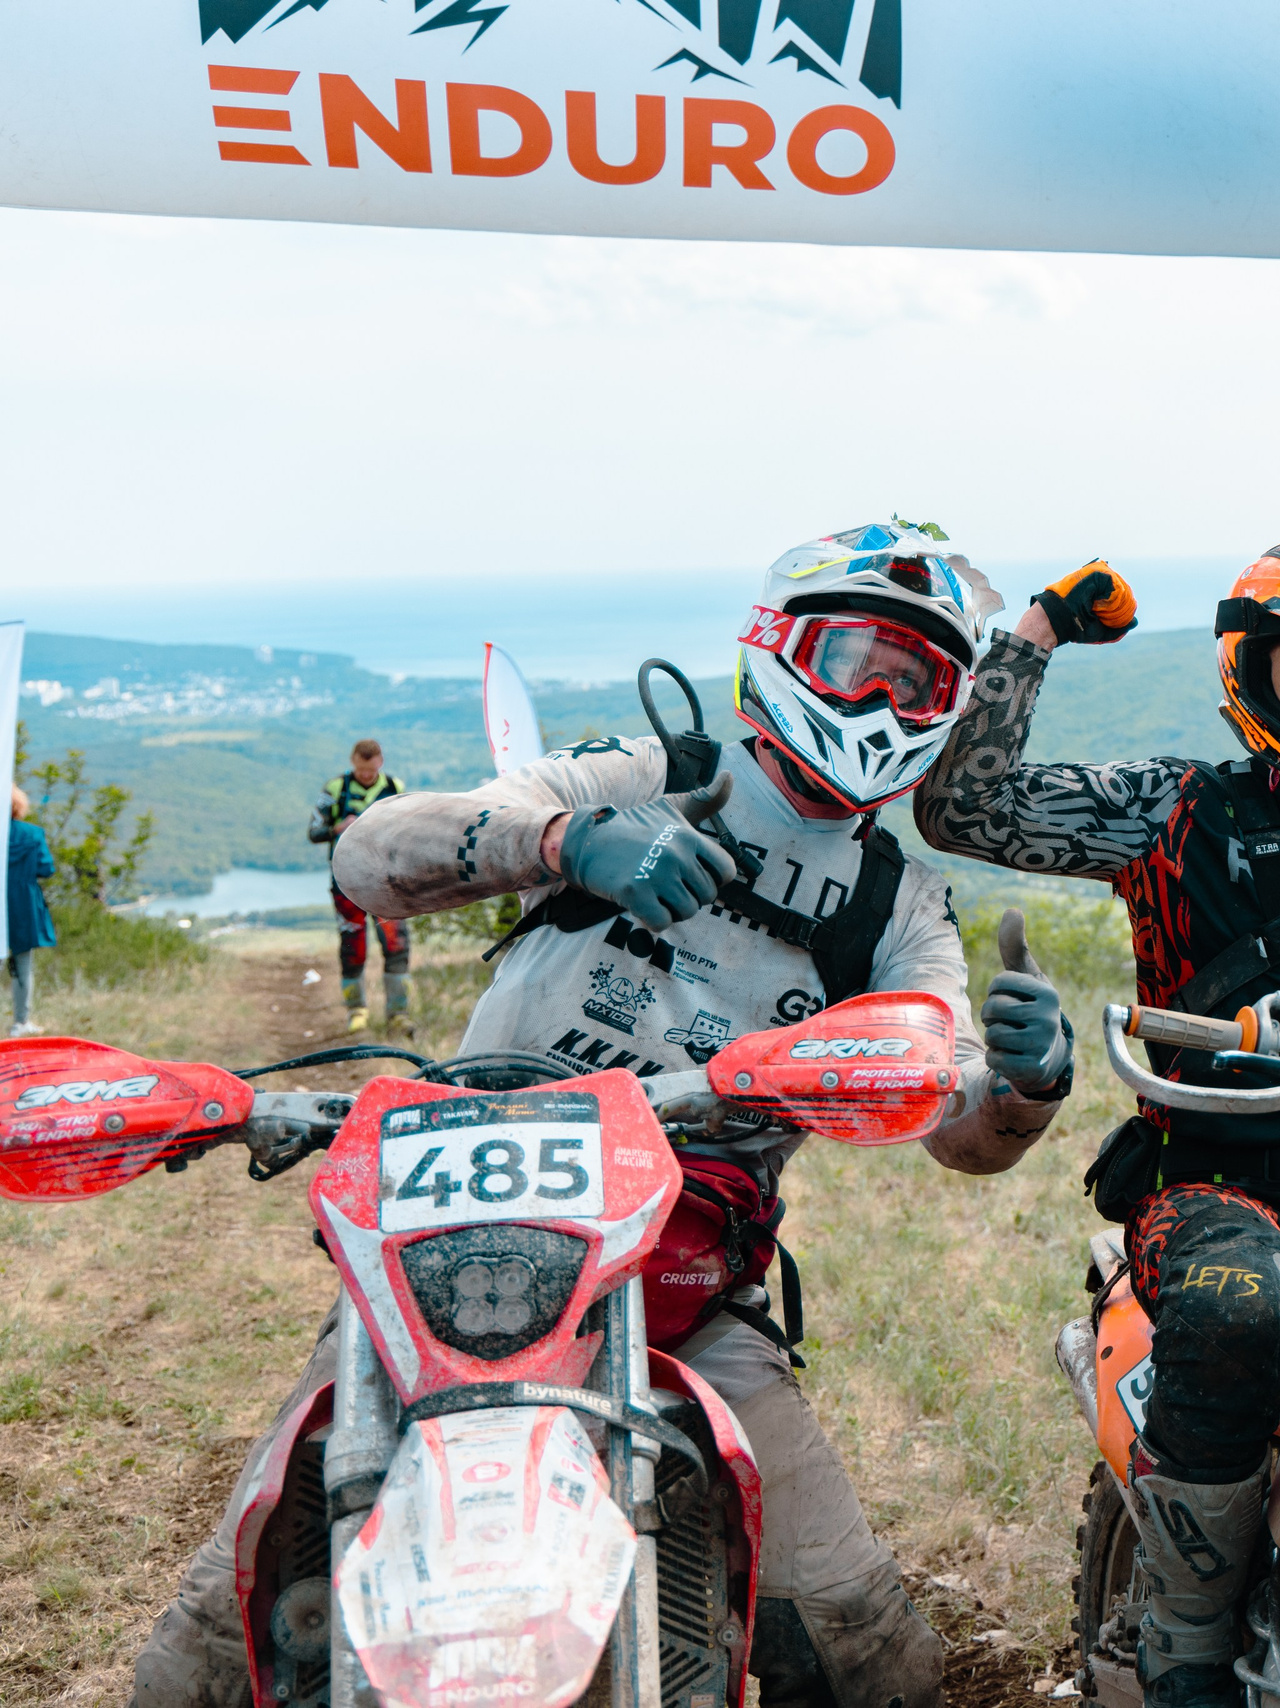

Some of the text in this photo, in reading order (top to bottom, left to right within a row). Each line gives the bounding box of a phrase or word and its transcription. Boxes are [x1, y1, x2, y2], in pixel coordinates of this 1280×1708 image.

[208, 64, 896, 196] ENDURO
[634, 822, 681, 881] VECTOR
[676, 948, 718, 970] НПО РТИ
[845, 1079, 925, 1090] FOR ENDURO
[852, 1068, 926, 1079] PROTECTION
[9, 1114, 99, 1134] PROCTION
[442, 1109, 480, 1120] TAKAYAMA
[35, 1126, 96, 1143] ENDURO
[396, 1138, 590, 1208] 485
[1181, 1263, 1264, 1298] LET'S
[522, 1382, 612, 1412] bynature
